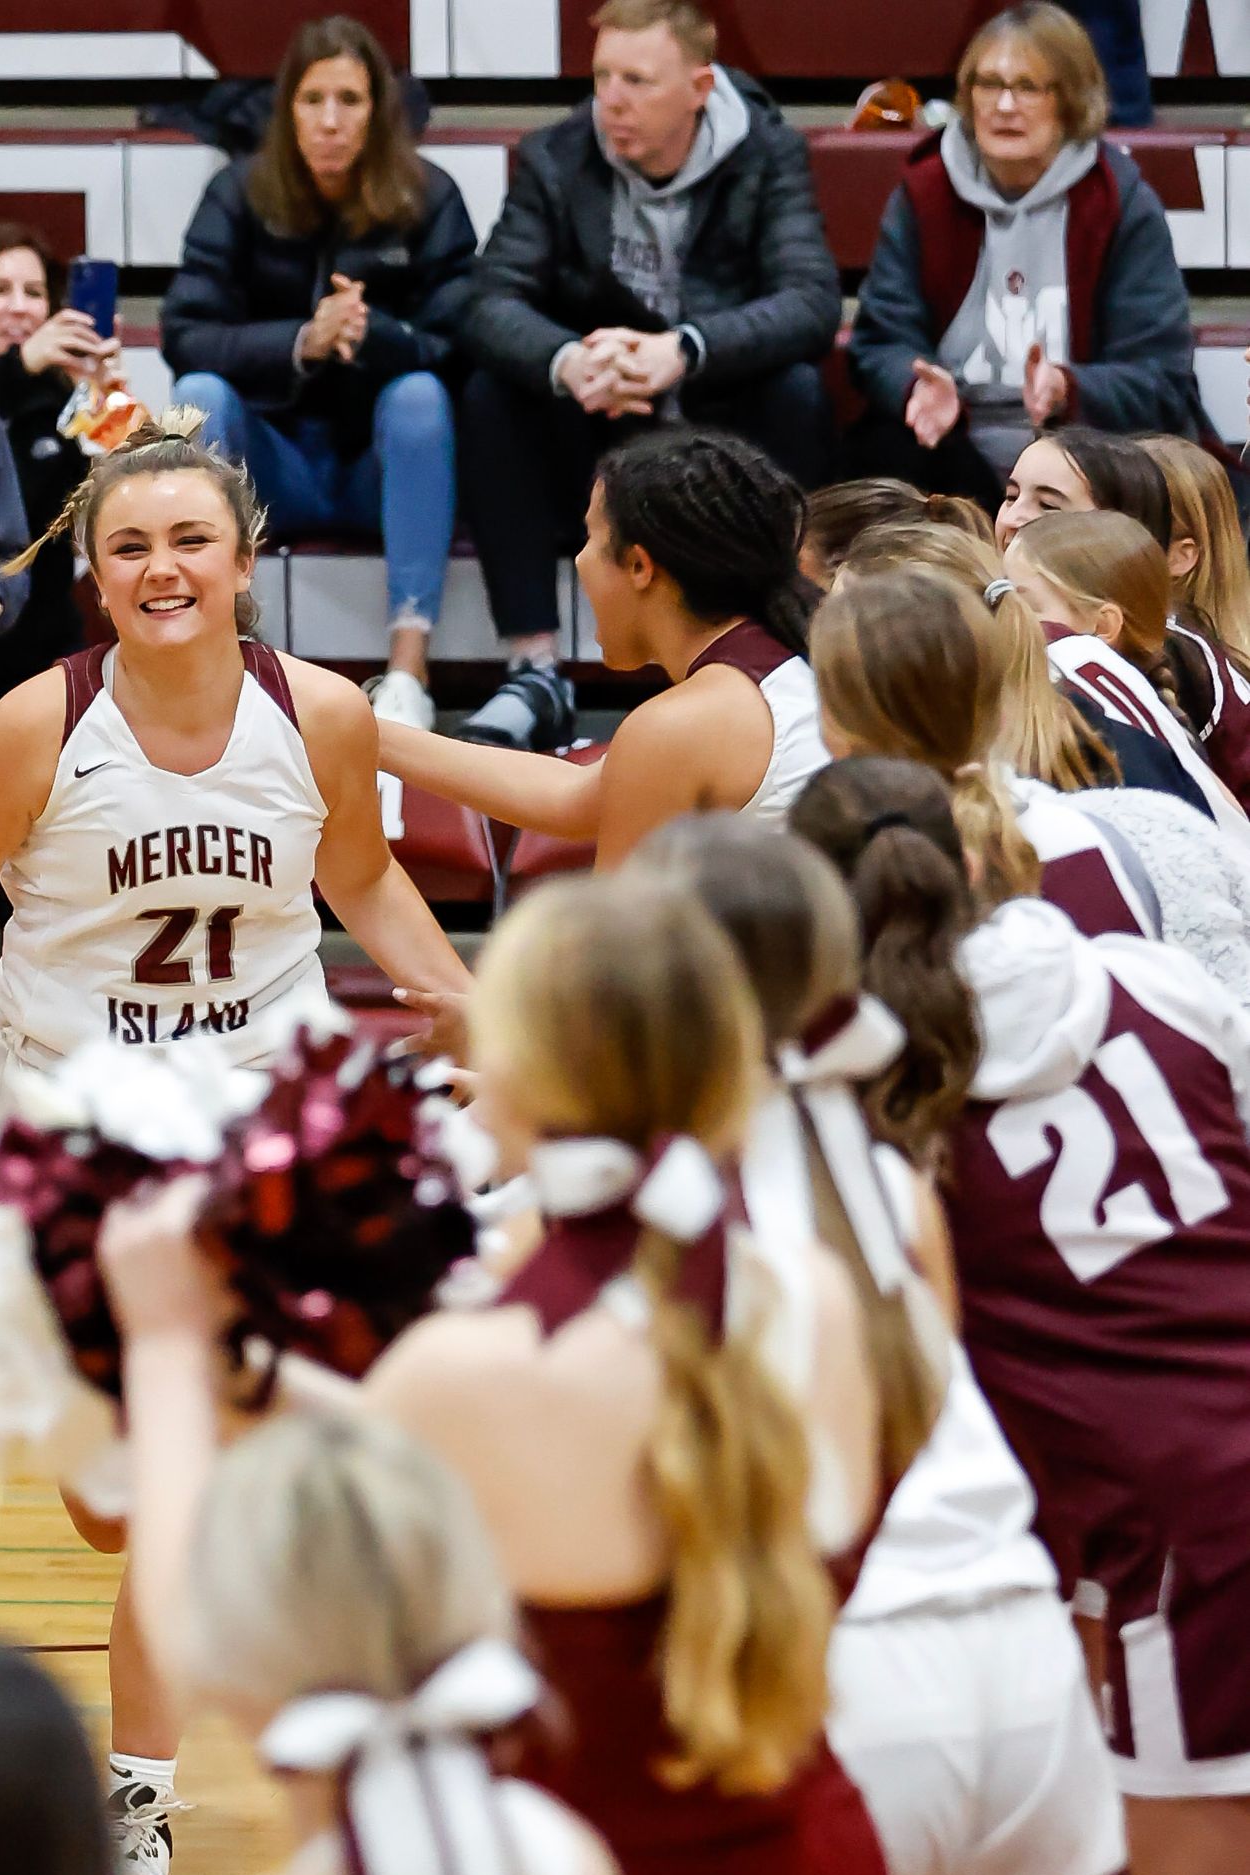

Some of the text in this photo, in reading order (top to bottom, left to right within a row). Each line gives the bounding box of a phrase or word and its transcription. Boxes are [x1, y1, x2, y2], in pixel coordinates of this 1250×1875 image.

[107, 824, 273, 895] MERCER
[131, 904, 244, 986] 21
[986, 1031, 1231, 1284] 21
